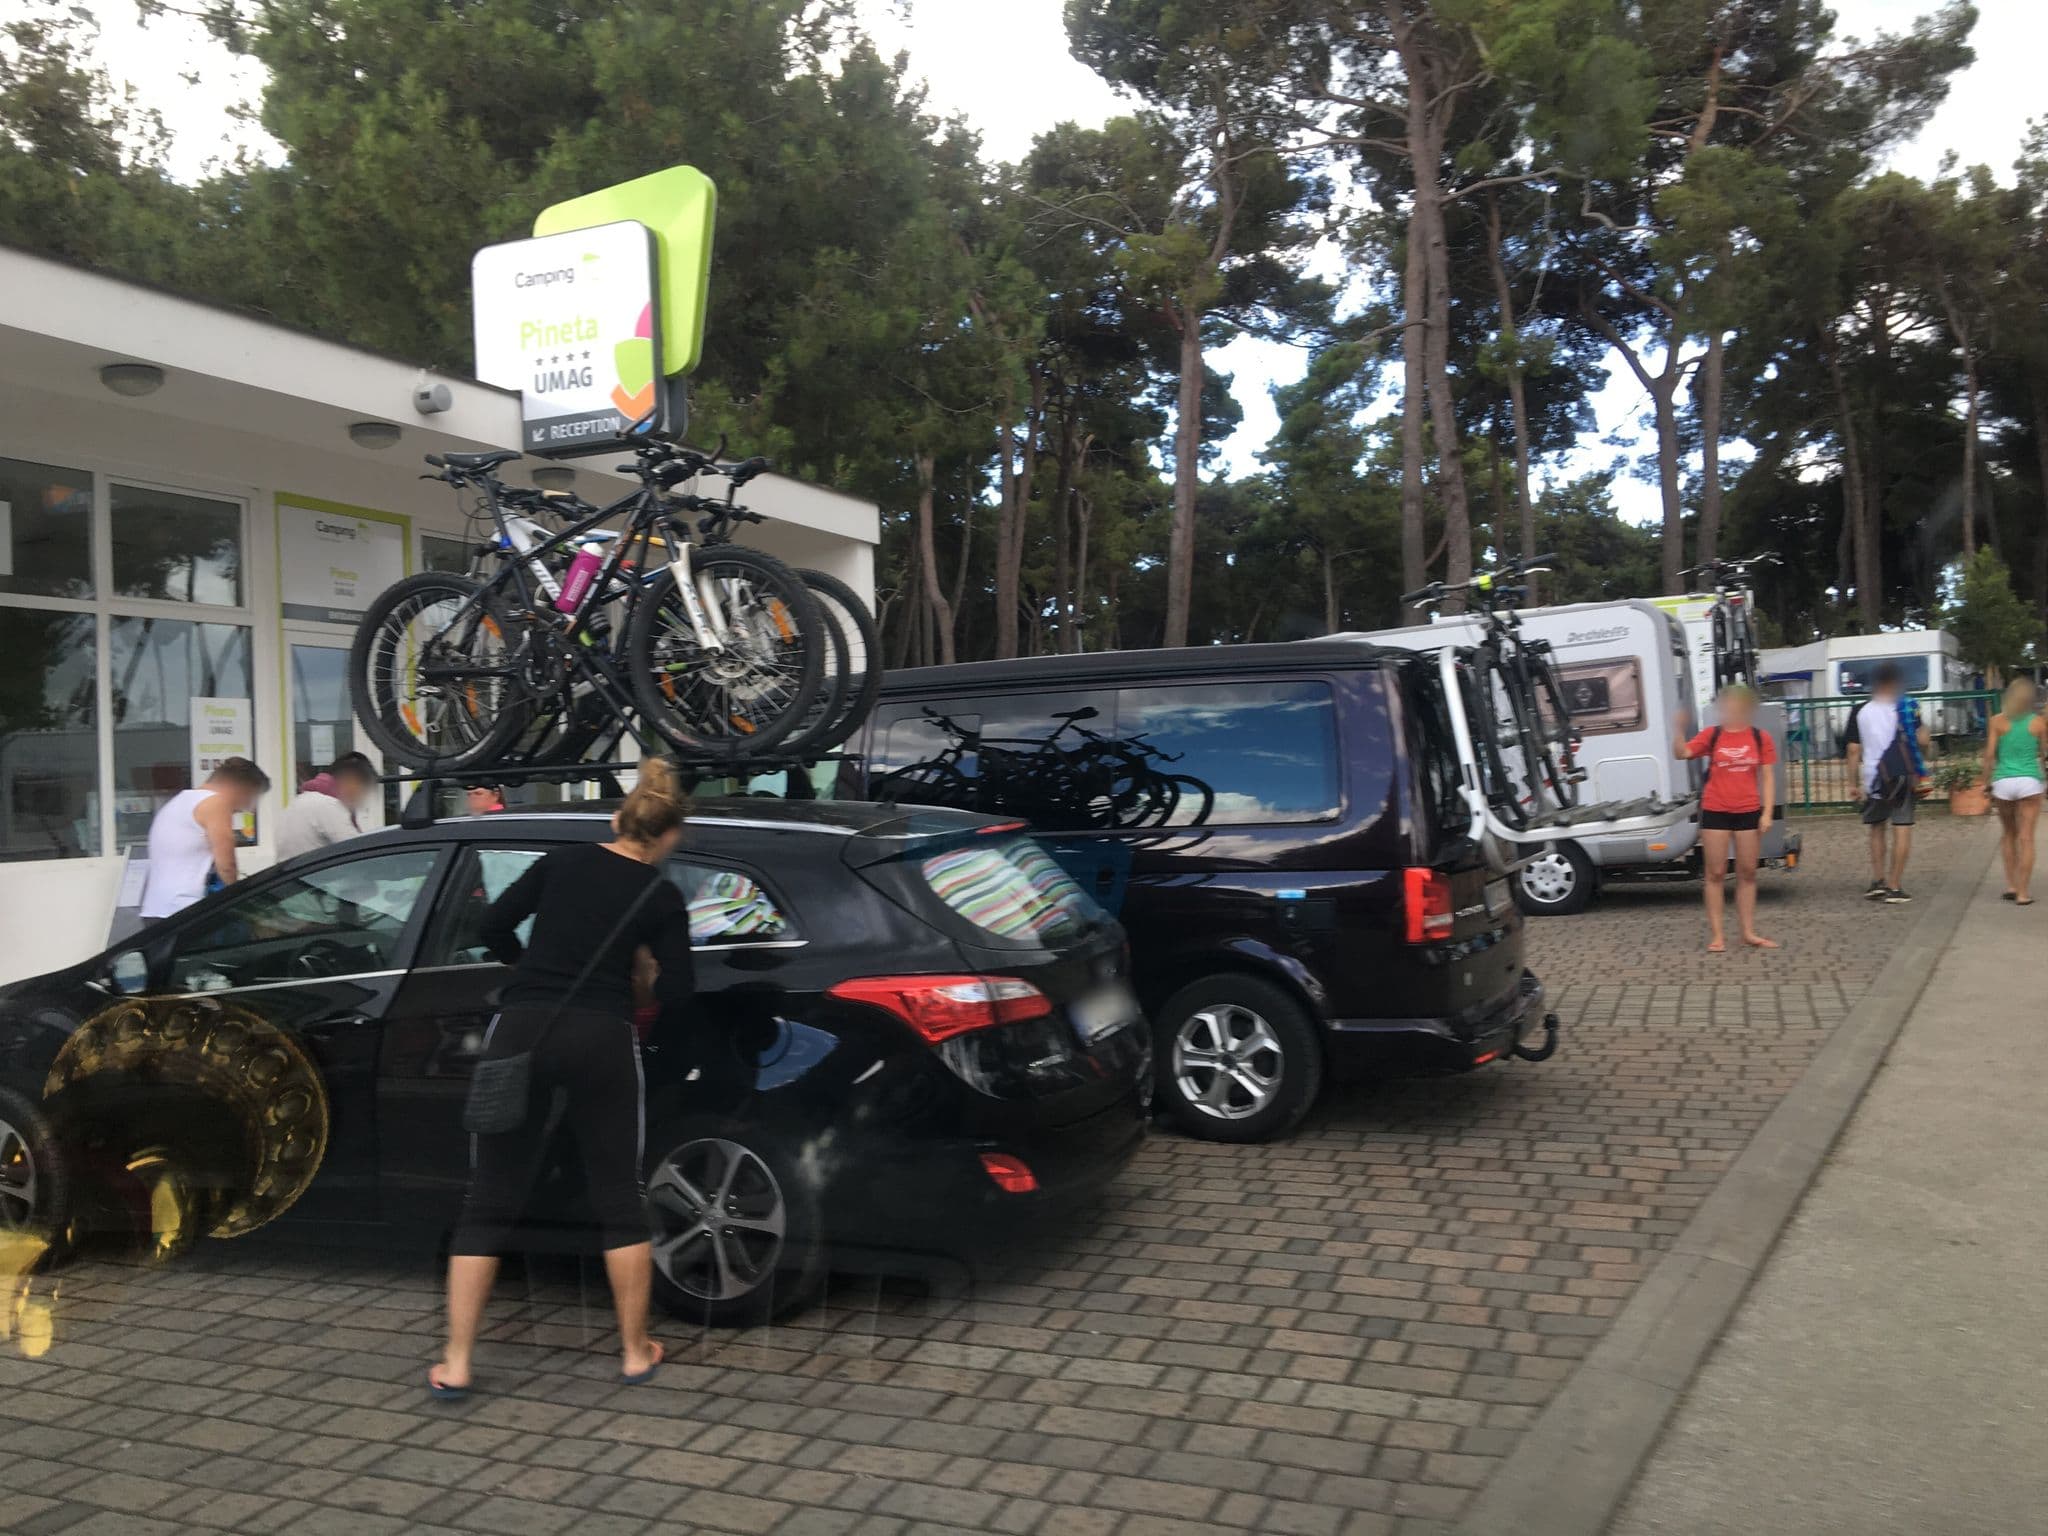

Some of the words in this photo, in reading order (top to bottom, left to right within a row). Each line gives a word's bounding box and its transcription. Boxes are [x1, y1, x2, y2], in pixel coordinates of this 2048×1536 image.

[515, 267, 575, 288] Camping
[520, 315, 599, 349] Pineta
[534, 366, 593, 394] UMAG
[550, 416, 621, 439] RECEPTION
